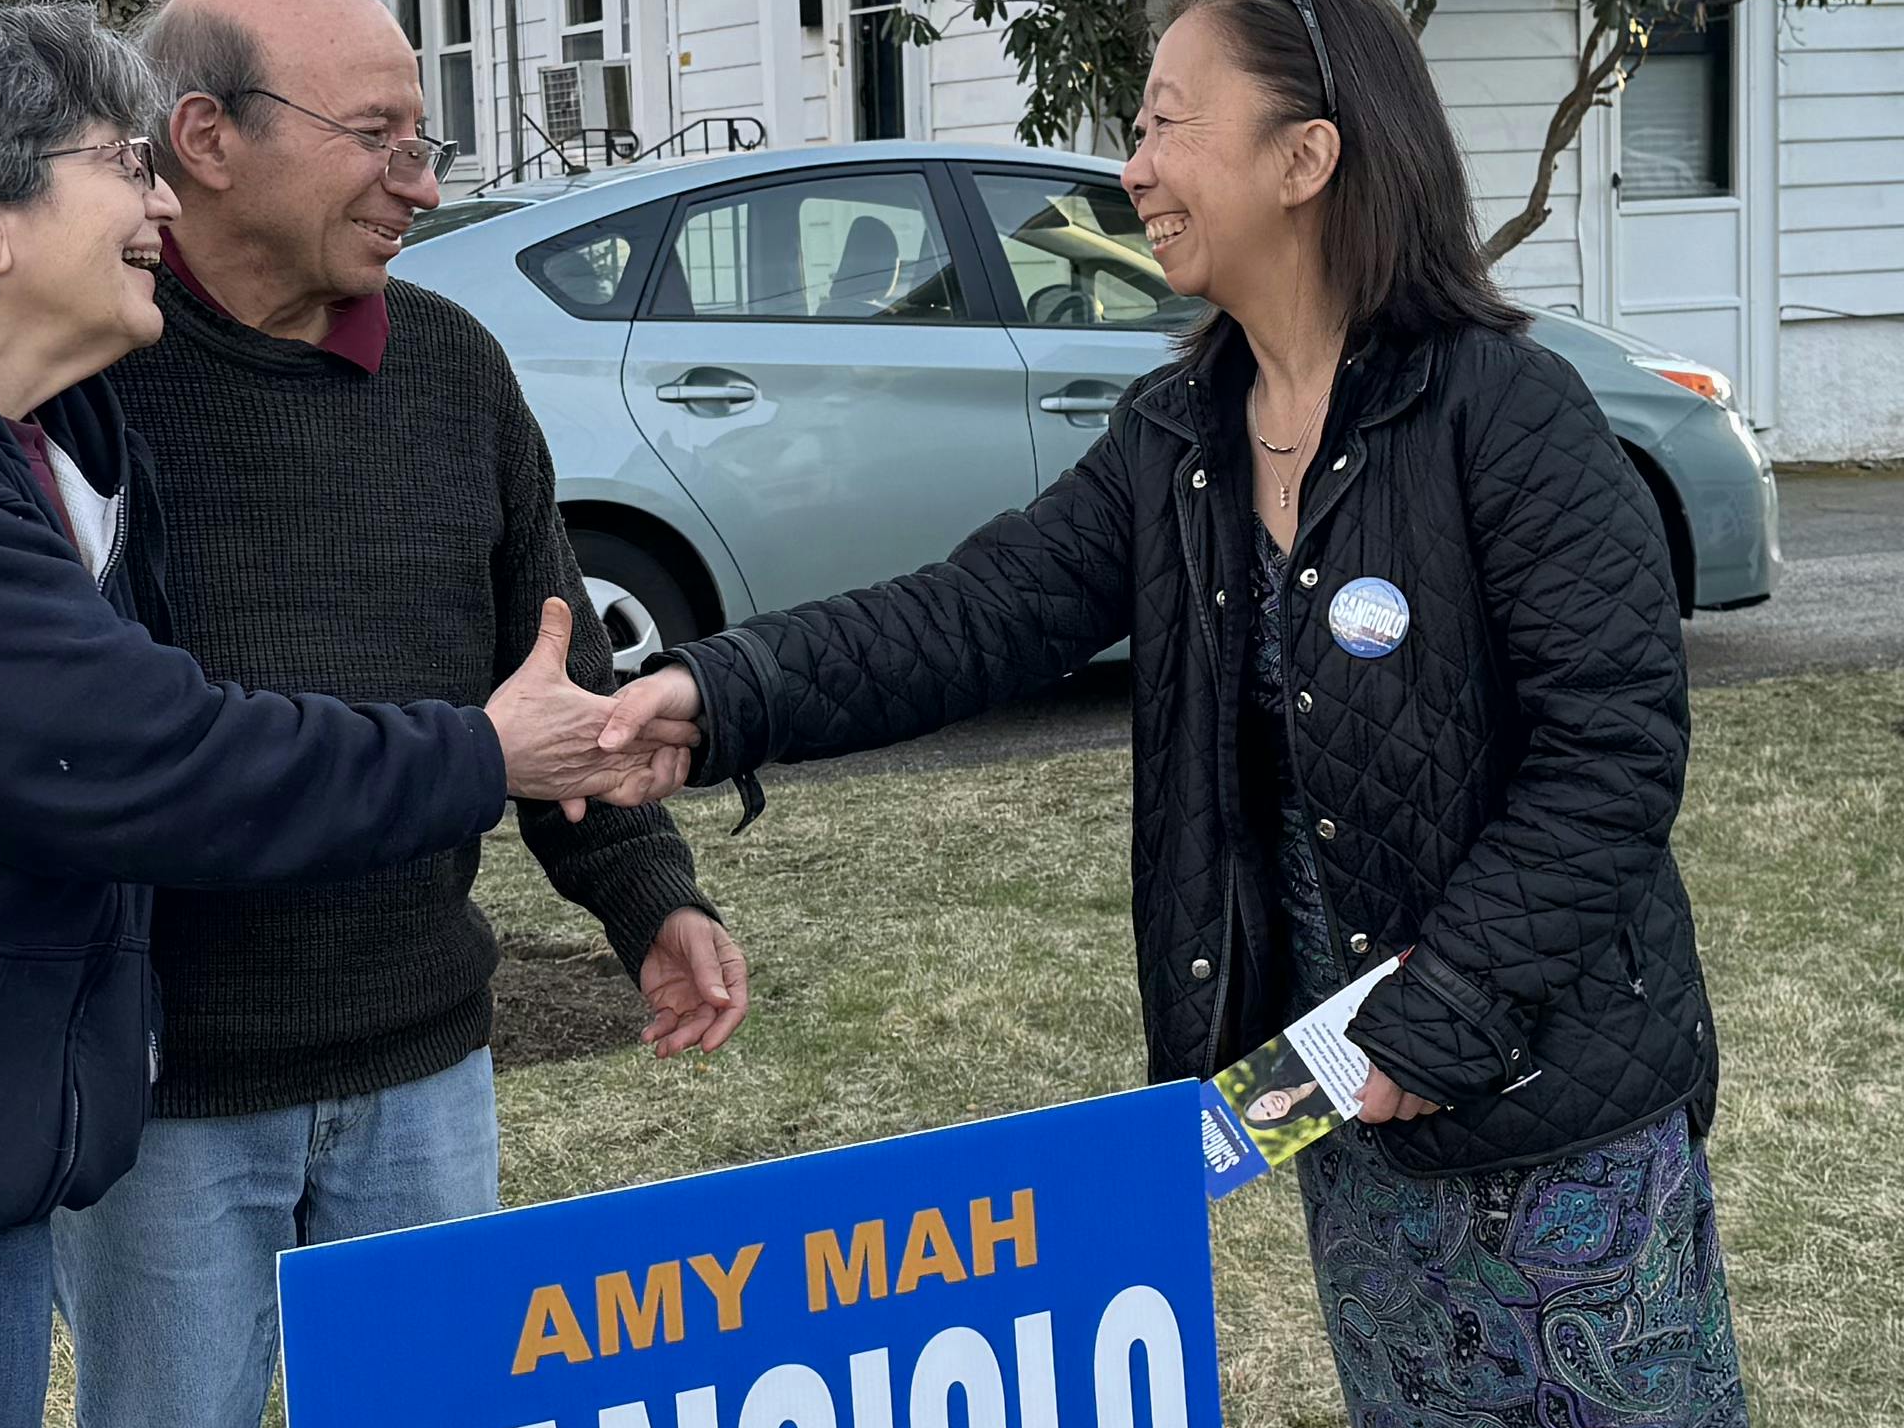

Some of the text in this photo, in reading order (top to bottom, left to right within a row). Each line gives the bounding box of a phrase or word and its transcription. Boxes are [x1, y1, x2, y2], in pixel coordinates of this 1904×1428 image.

[1334, 593, 1406, 640] SANGIOLO
[512, 1189, 1037, 1374] AMY MAH
